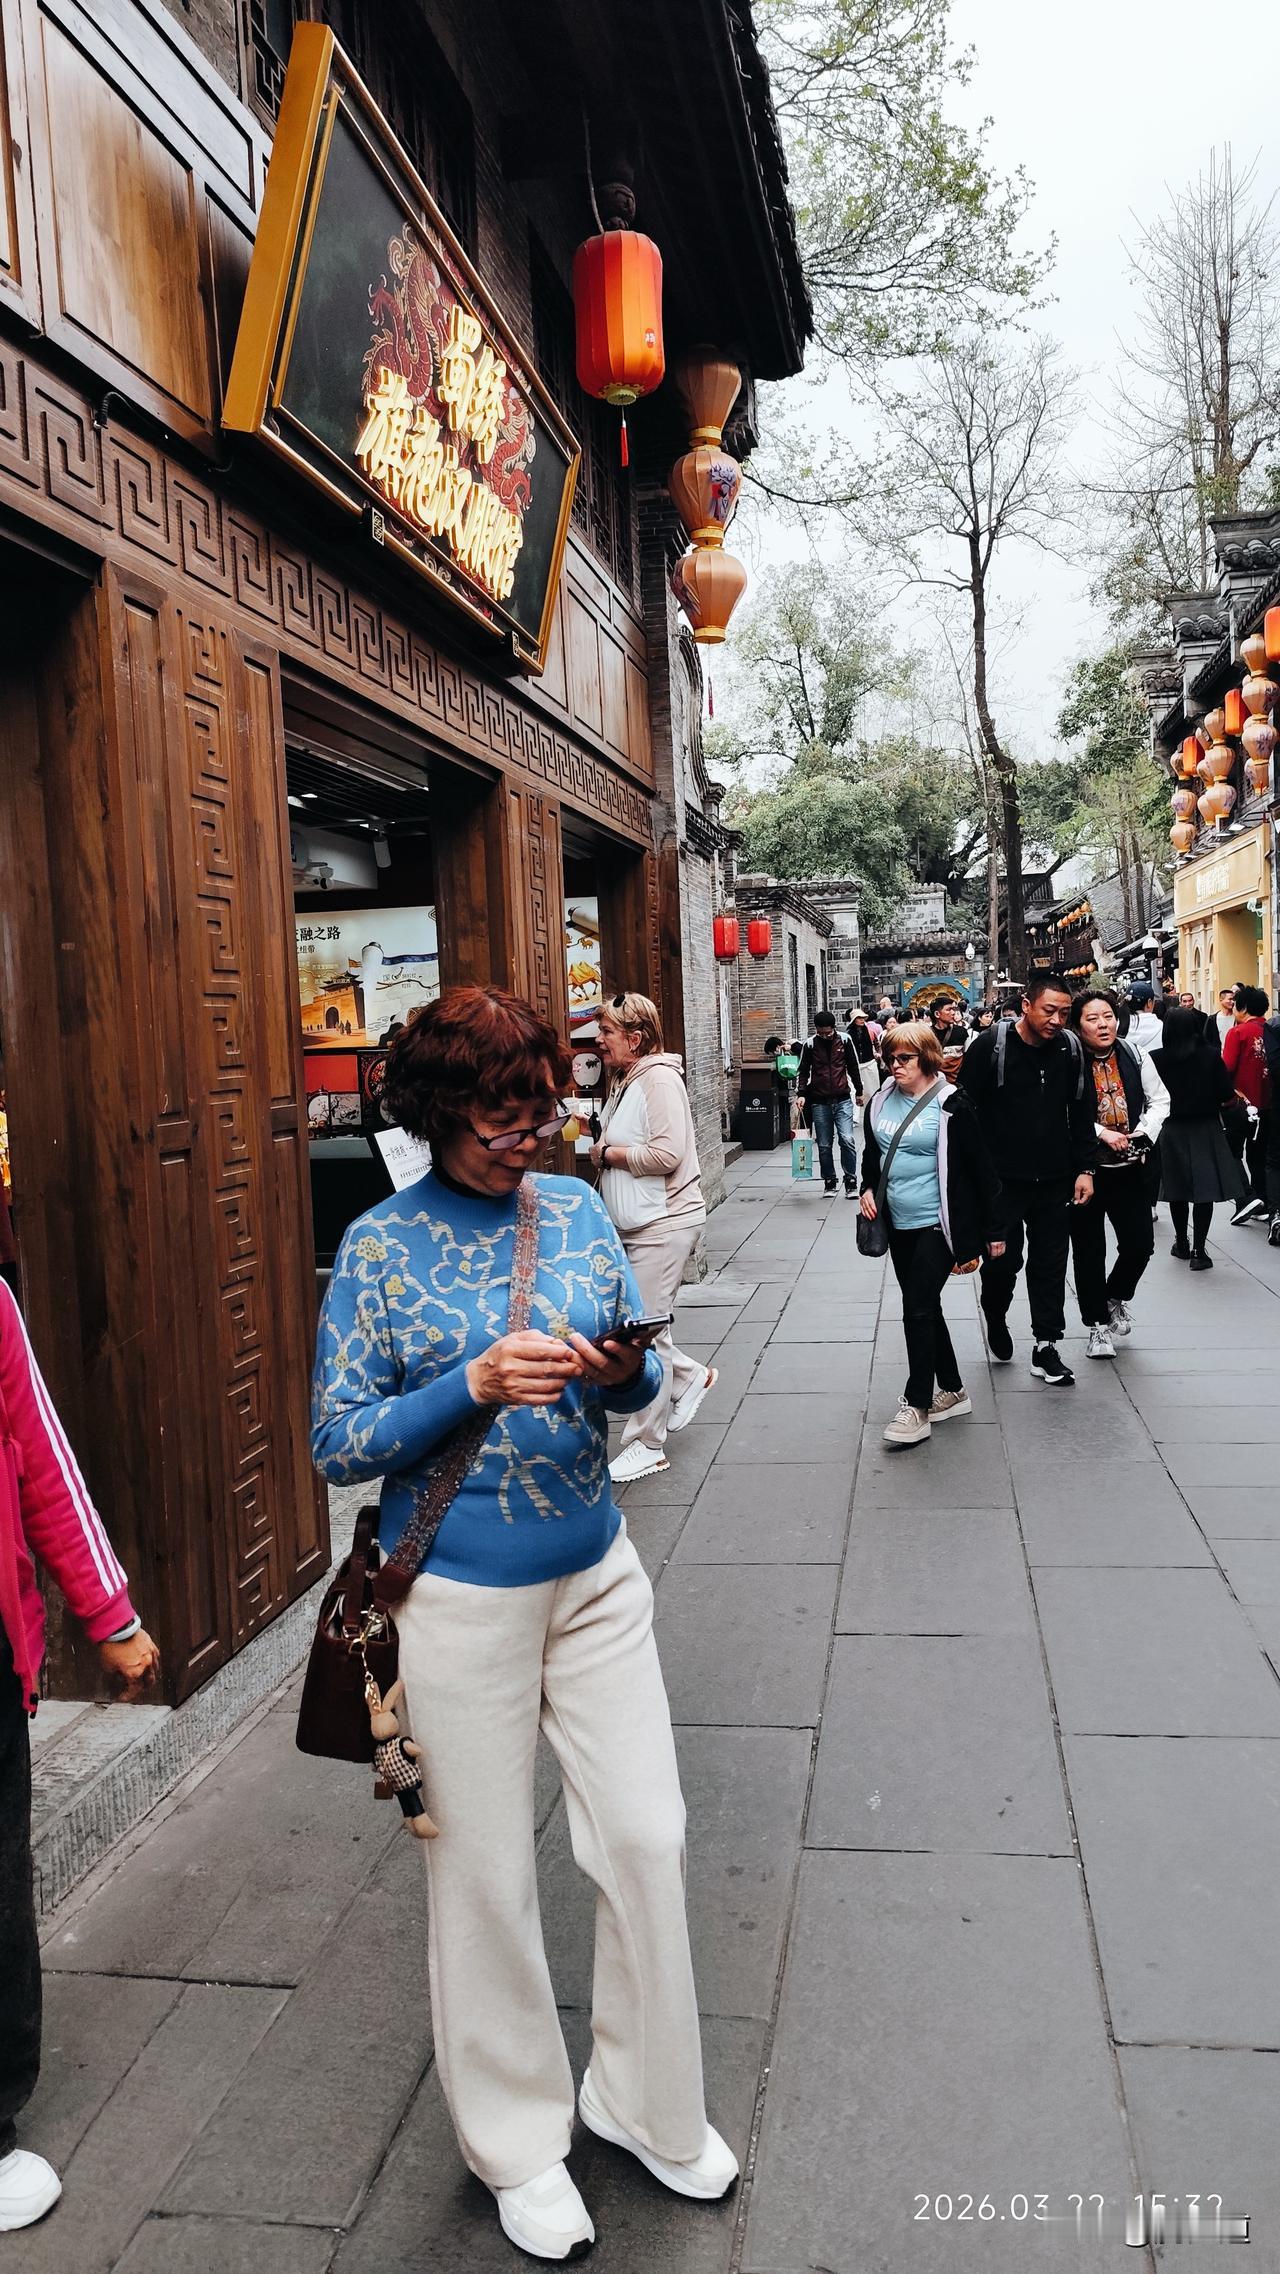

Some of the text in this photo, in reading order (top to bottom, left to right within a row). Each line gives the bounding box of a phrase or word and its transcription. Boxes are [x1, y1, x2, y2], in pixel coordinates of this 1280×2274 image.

[439, 304, 507, 465] 蜀绣
[355, 366, 523, 601] 旗袍汉服馆
[877, 1119, 915, 1137] PUA
